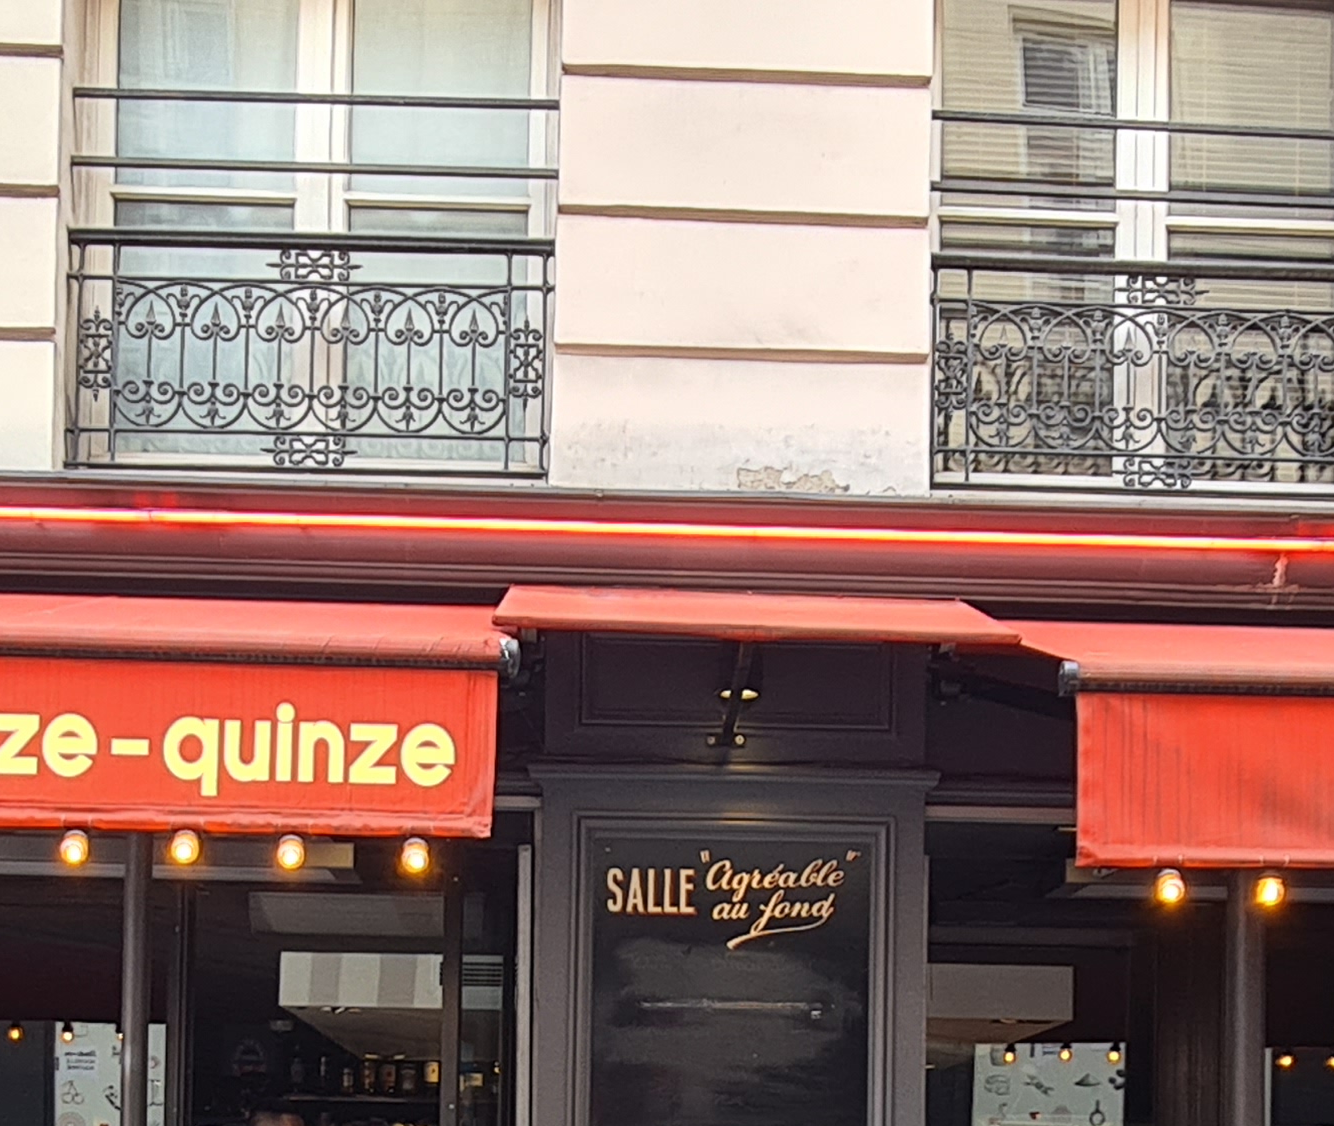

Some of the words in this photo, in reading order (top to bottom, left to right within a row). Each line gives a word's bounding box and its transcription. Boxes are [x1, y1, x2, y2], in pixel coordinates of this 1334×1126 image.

[606, 867, 698, 915] SALLE
[712, 901, 749, 921] au
[739, 890, 836, 940] fond
